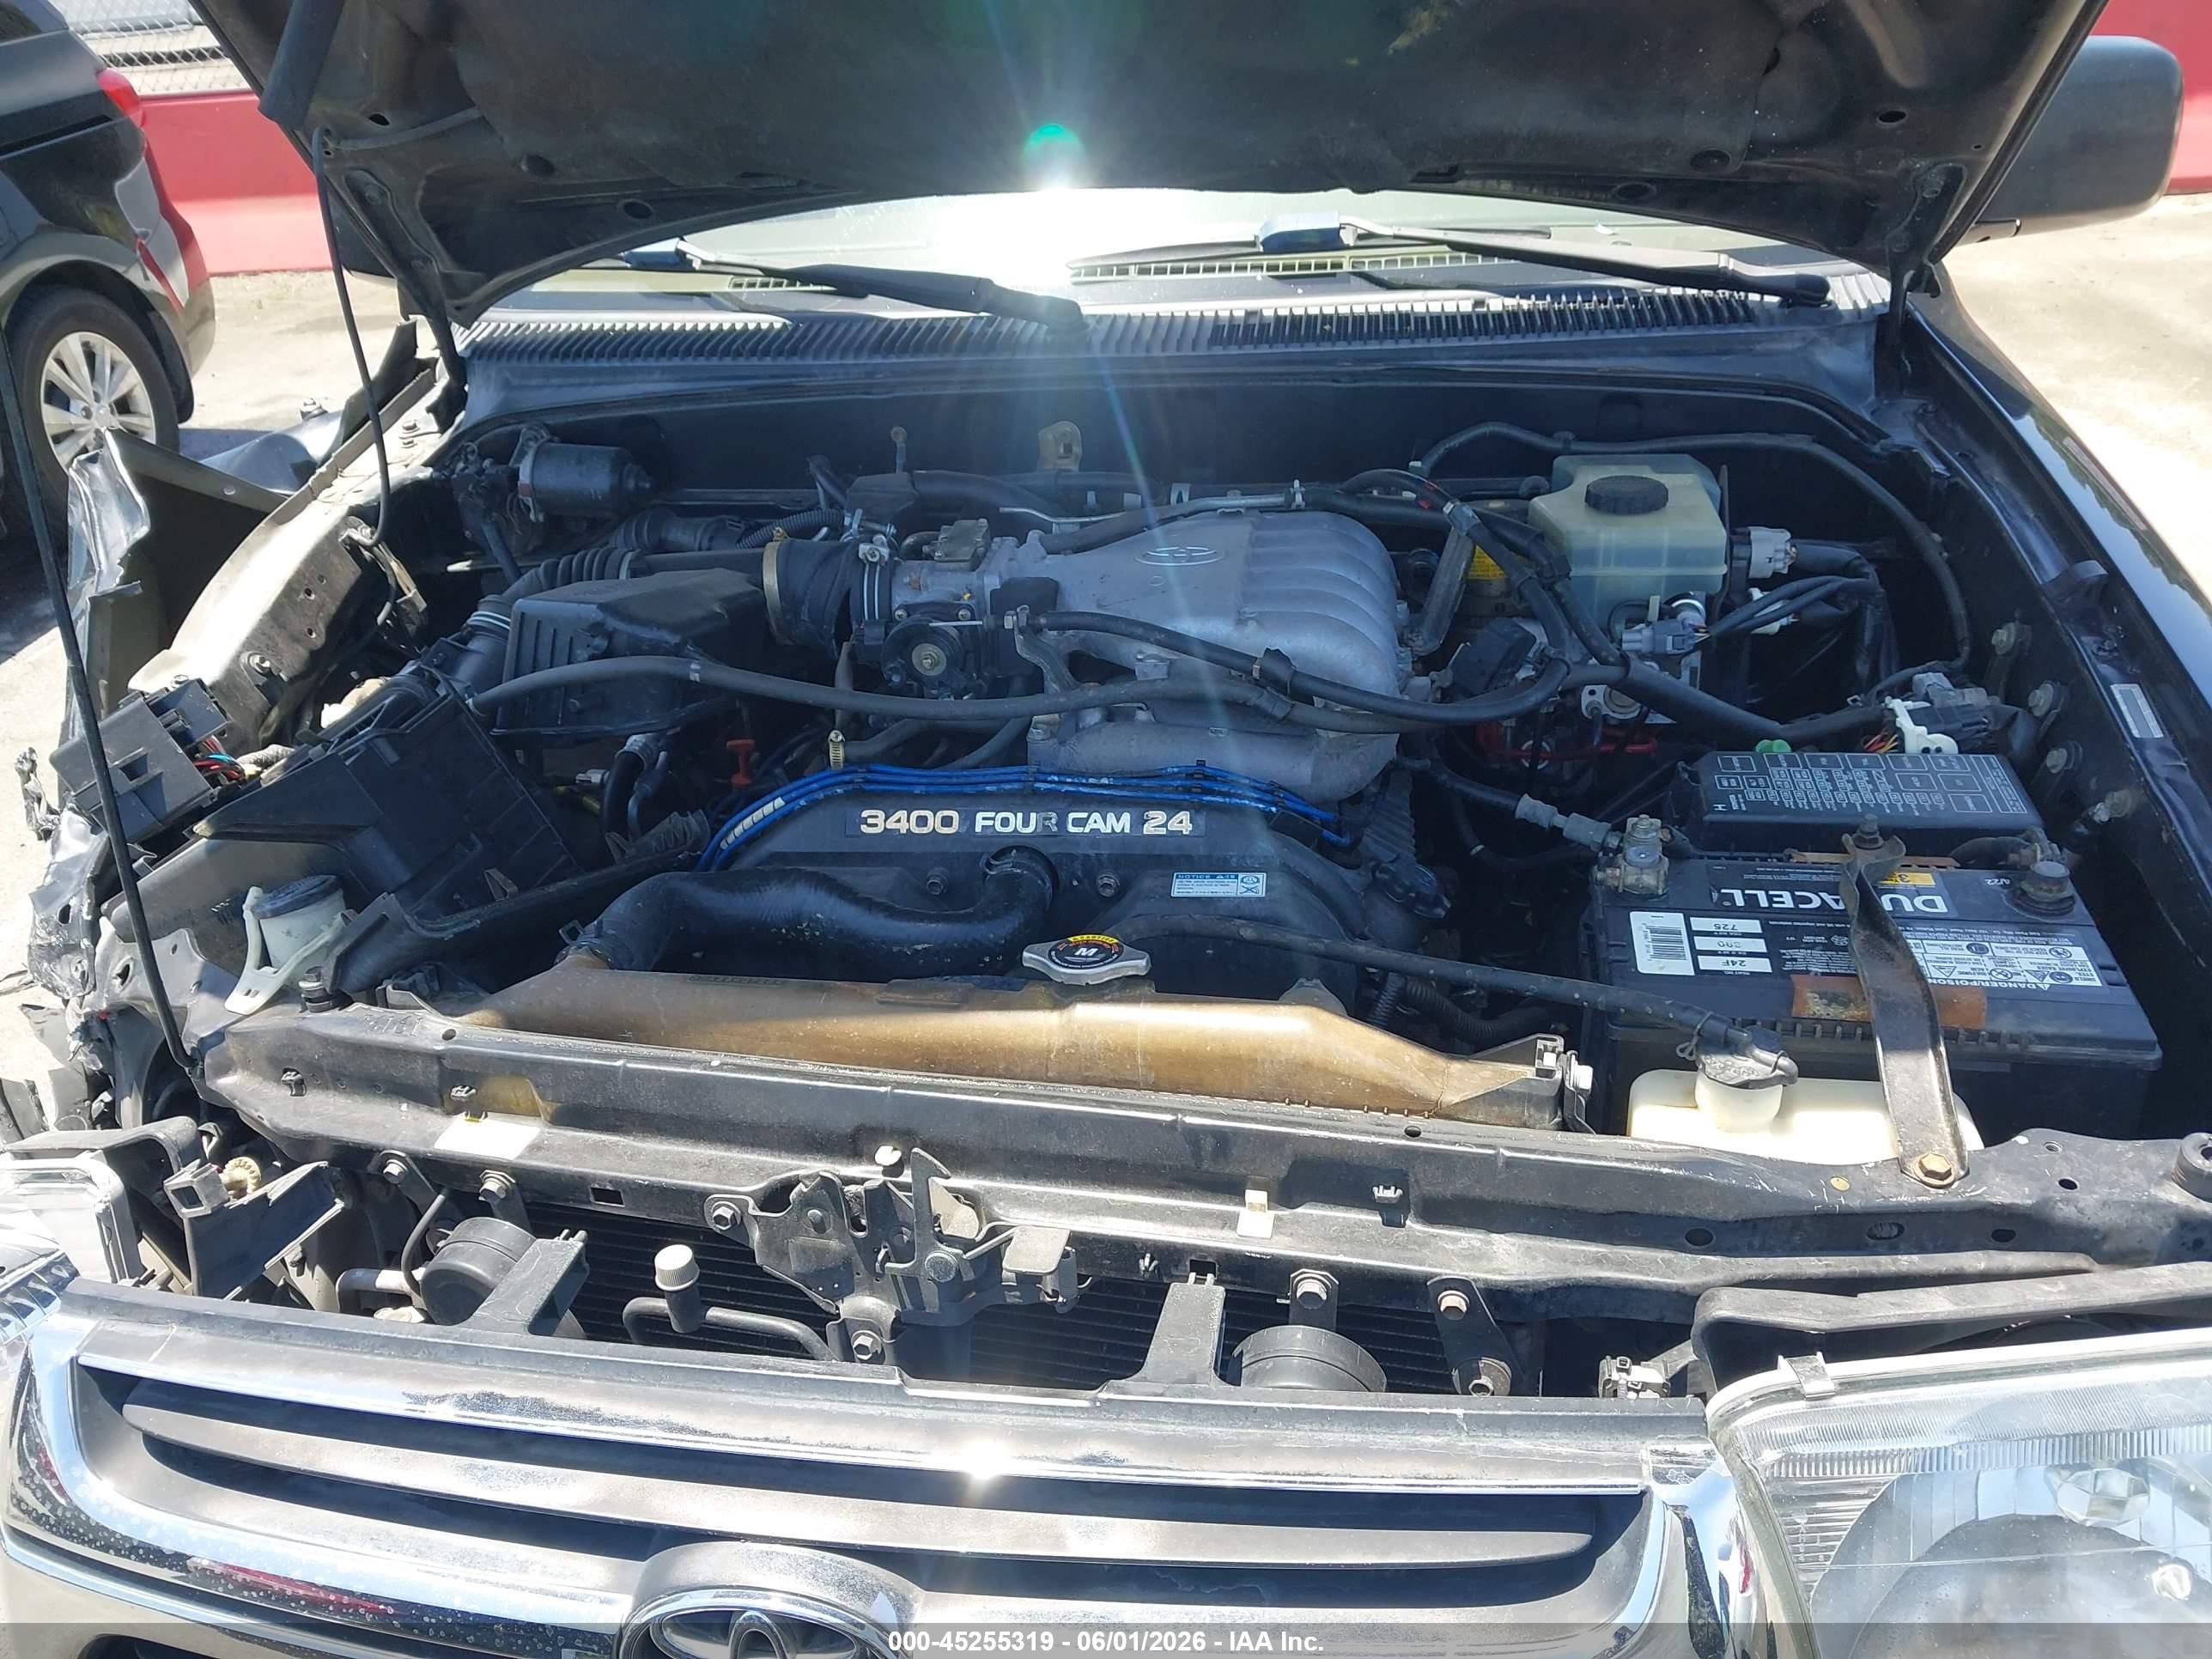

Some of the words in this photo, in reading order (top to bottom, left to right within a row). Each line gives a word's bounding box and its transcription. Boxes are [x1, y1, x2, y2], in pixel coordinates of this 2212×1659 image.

[859, 809, 959, 834] 3400
[975, 811, 1058, 834] FOUR
[1066, 811, 1131, 834] CAM
[1142, 810, 1193, 835] 24
[1721, 889, 1948, 912] DUACELL
[1927, 979, 2037, 989] DANGER/POISON
